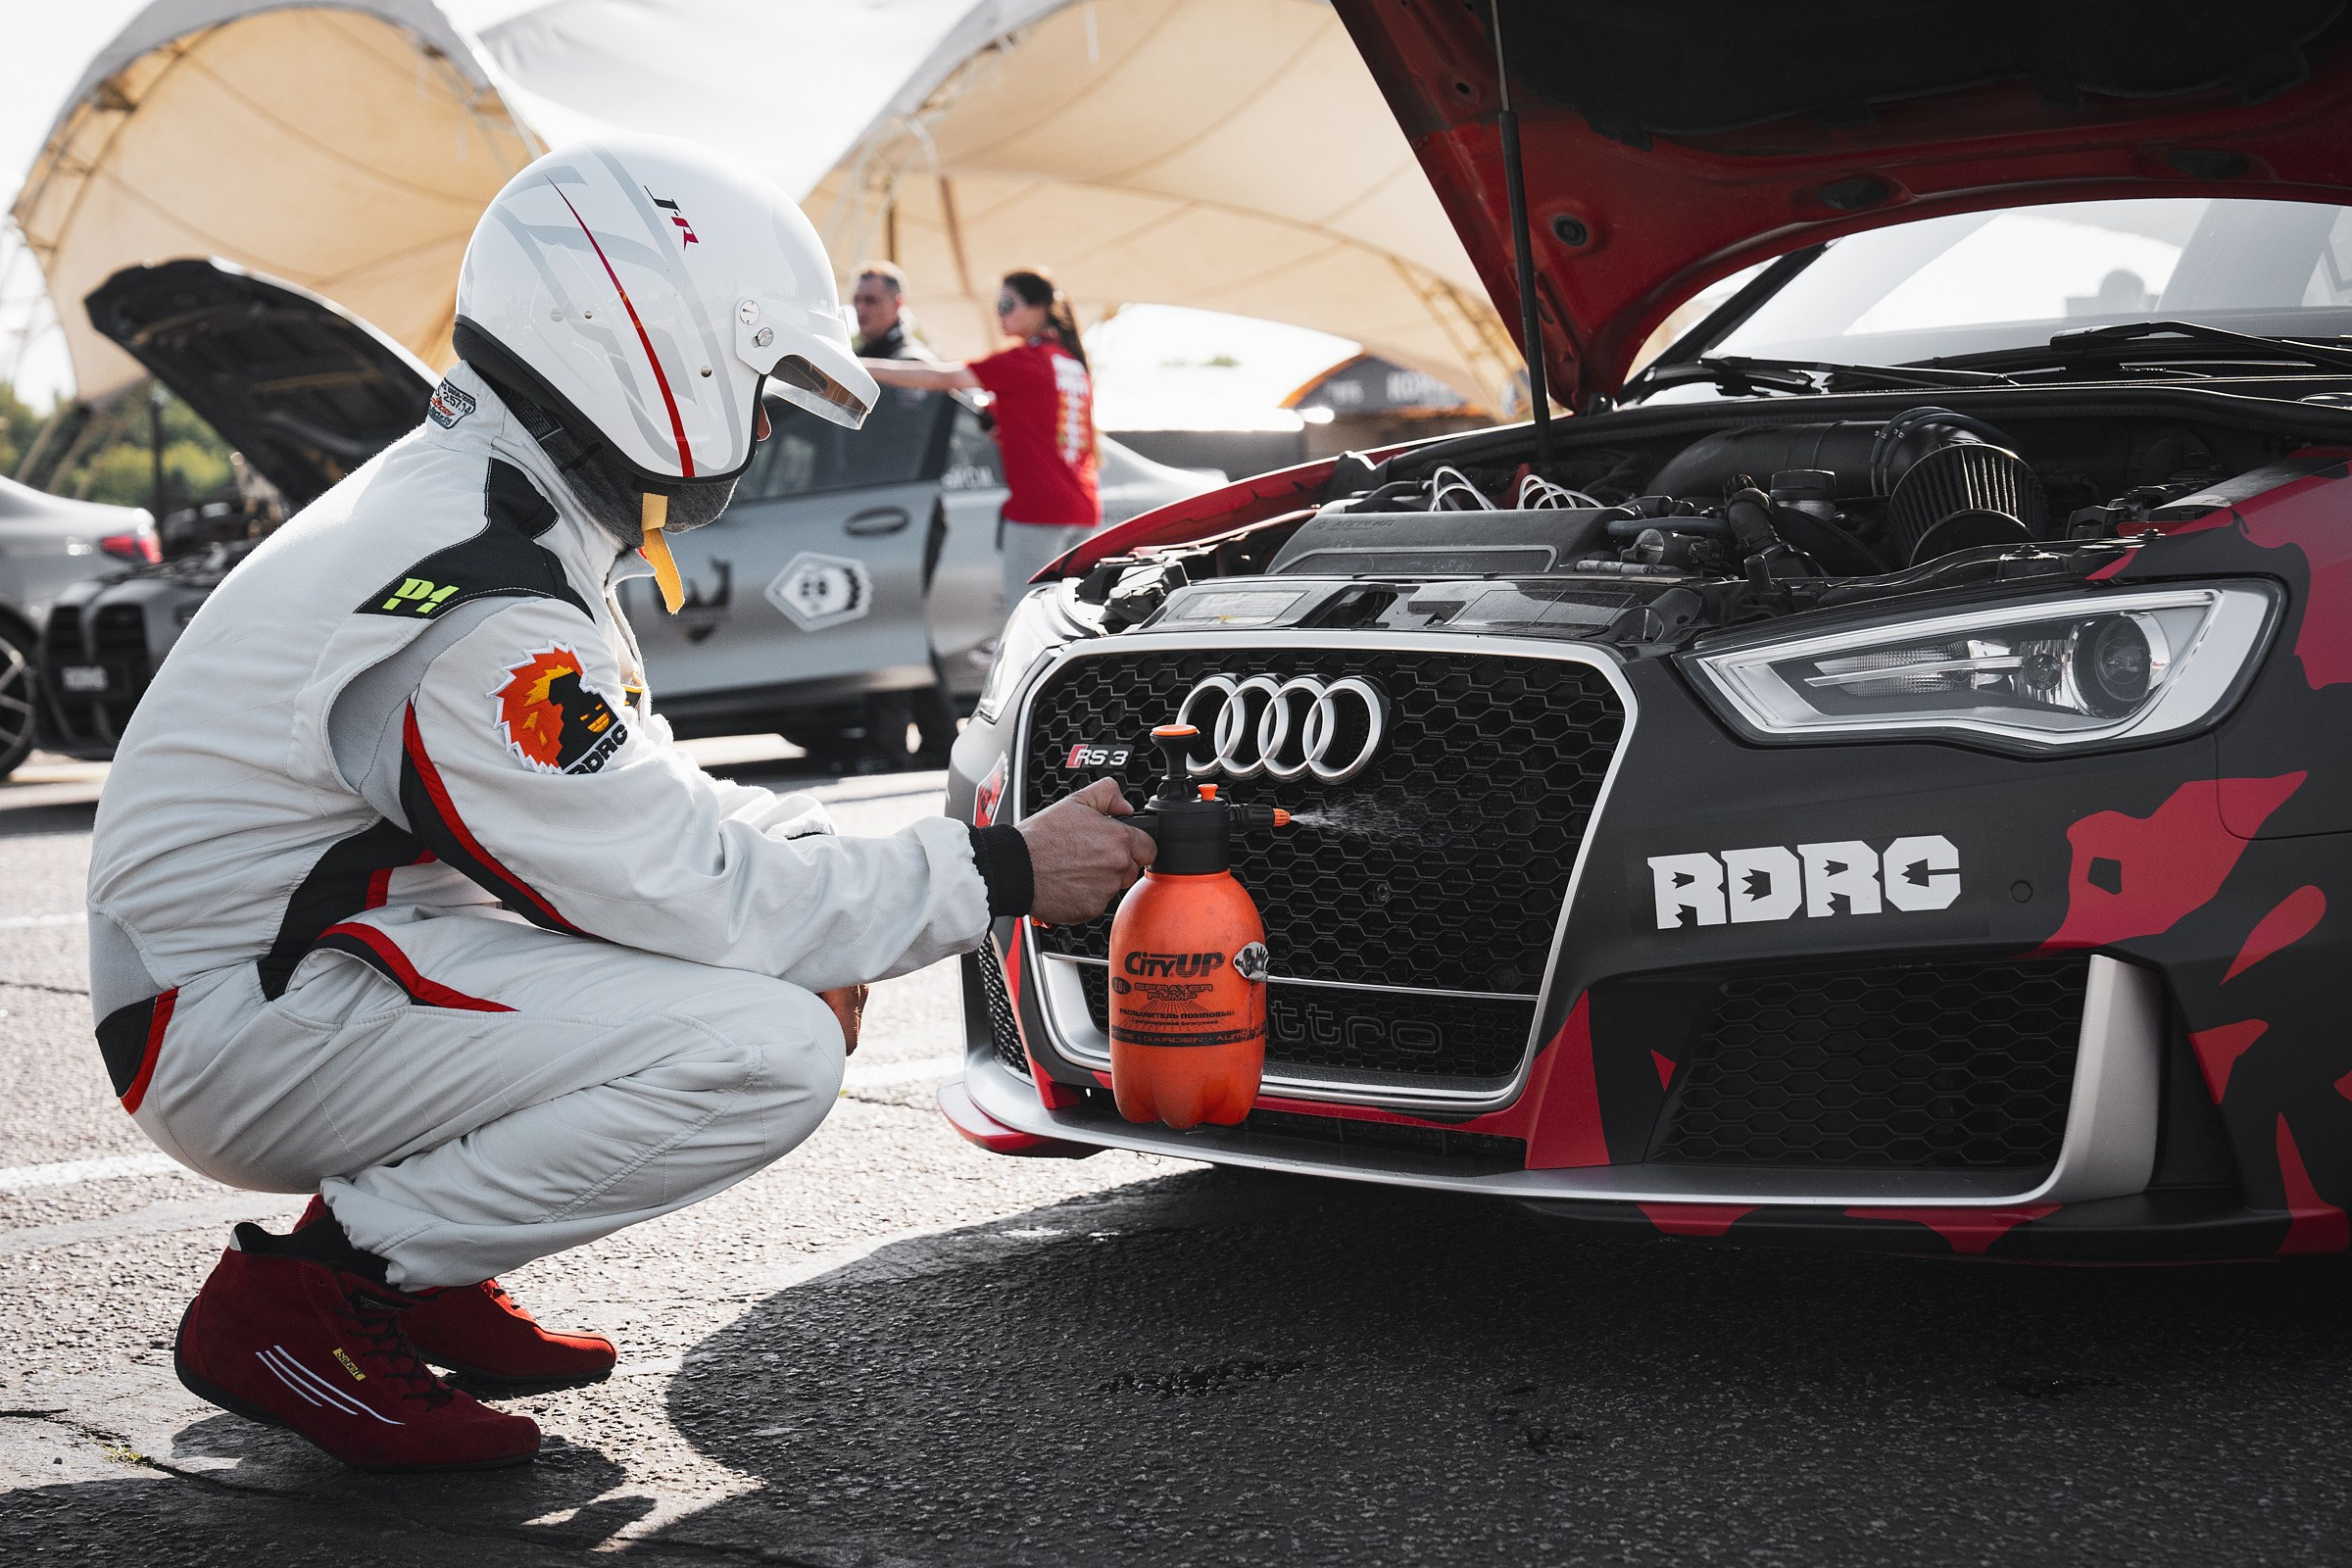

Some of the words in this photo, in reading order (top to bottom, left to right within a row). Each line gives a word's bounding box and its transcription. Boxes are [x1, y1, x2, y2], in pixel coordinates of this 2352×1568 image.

[1074, 749, 1109, 765] RS
[1109, 750, 1129, 765] 3
[1646, 834, 1962, 930] RDRC
[1134, 983, 1214, 993] SPRAYER
[1148, 992, 1199, 1001] PUMP
[1269, 1000, 1444, 1054] ttro
[1144, 1035, 1203, 1044] GARDEN
